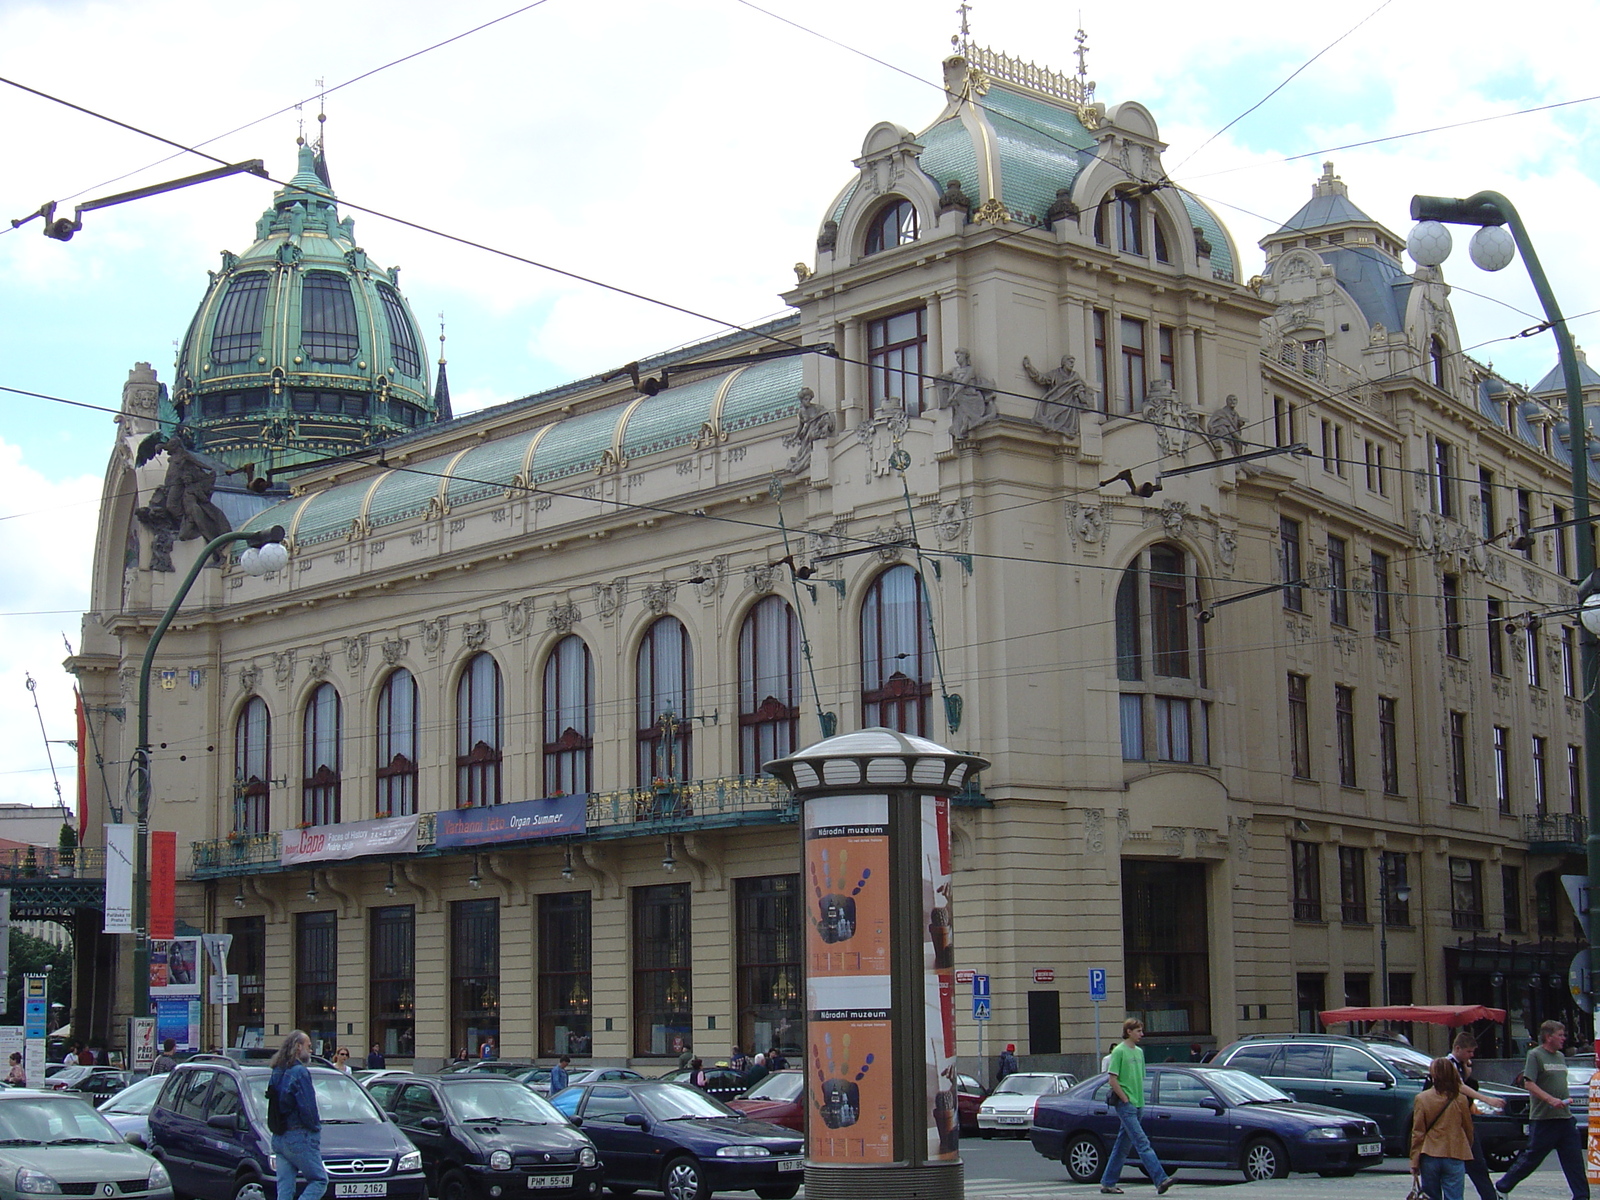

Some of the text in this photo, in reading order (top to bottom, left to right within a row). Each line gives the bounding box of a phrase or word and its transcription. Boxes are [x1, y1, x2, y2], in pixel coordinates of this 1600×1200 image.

[510, 815, 531, 829] Organ
[532, 813, 563, 825] Summer
[328, 832, 344, 841] Faces
[350, 829, 369, 840] History
[818, 827, 845, 836] Národní
[299, 830, 325, 856] Capa
[1093, 970, 1103, 989] P
[820, 1011, 848, 1019] Národní
[796, 1160, 804, 1169] 95
[531, 1176, 570, 1186] PHM 55-48
[342, 1183, 384, 1194] 3A2 2162
